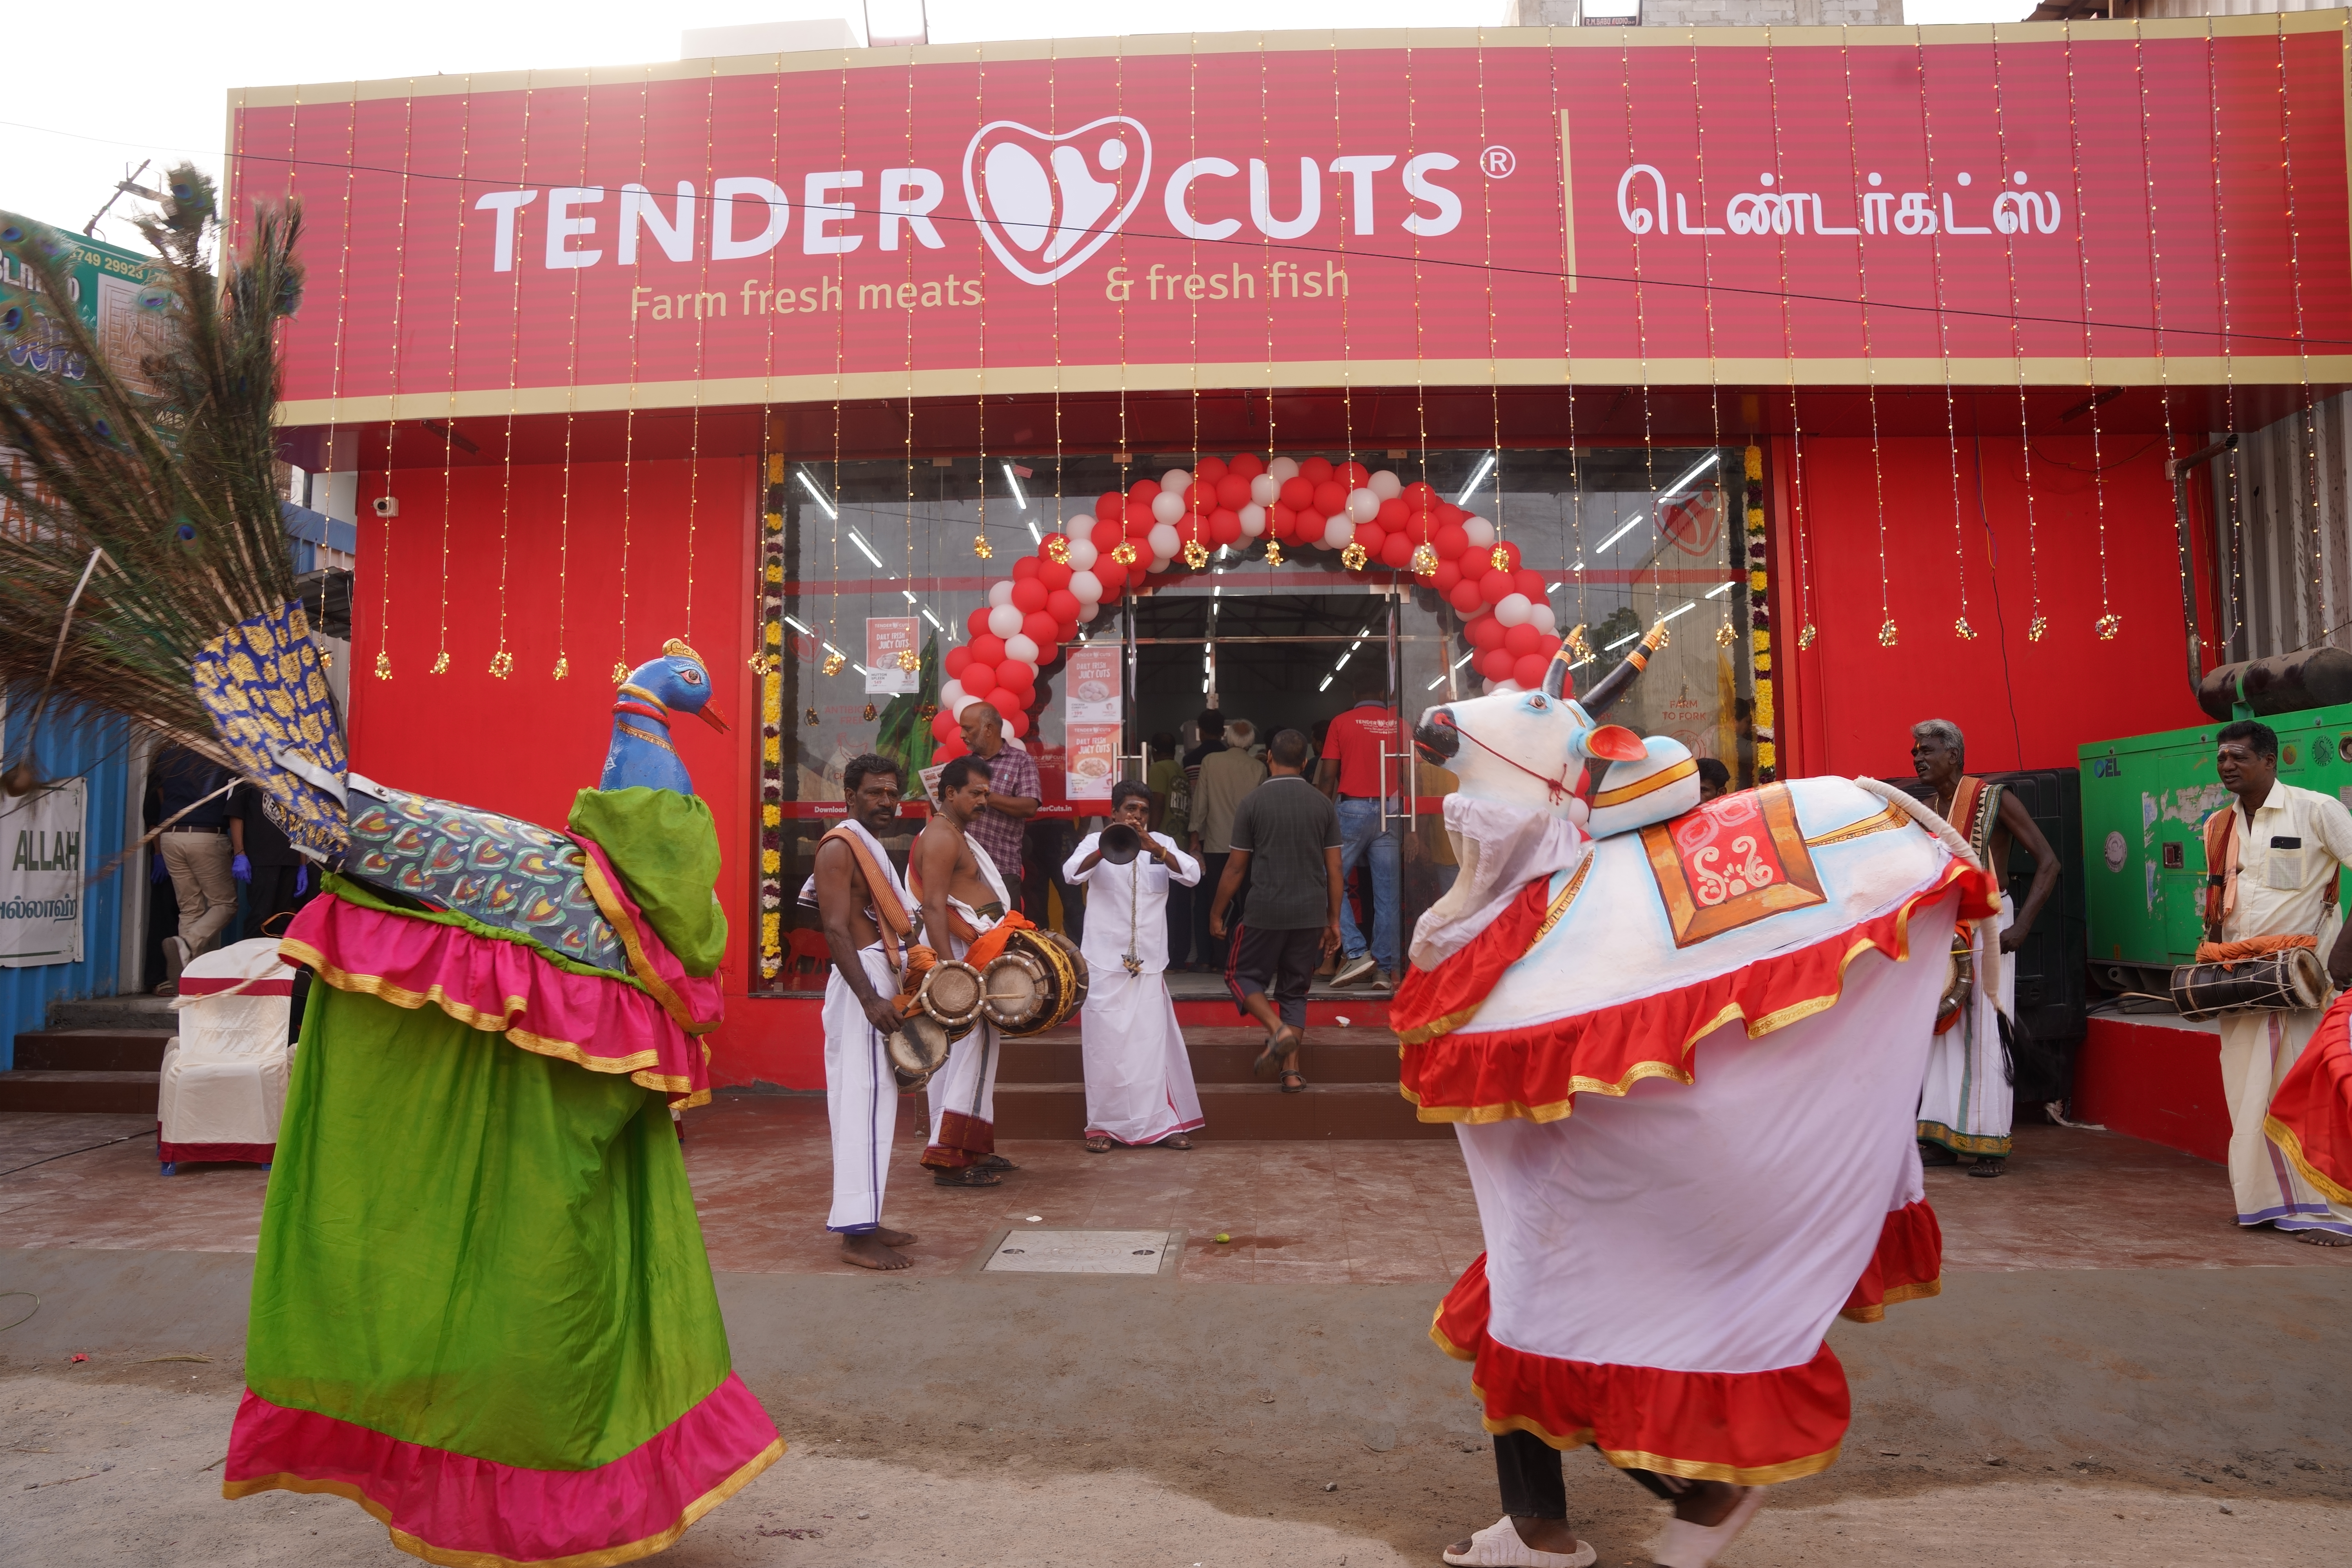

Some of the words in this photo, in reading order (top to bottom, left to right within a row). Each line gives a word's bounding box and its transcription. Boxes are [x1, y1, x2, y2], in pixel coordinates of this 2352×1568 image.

[1617, 164, 2061, 236] டெண்டர்கட்ஸ்
[474, 168, 946, 272] TENDER
[1164, 152, 1462, 240] CUTS
[1105, 266, 1134, 301] &
[1146, 262, 1255, 301] fresh
[1268, 260, 1349, 298] fish
[631, 287, 727, 321] Farm
[740, 276, 842, 315] fresh
[858, 274, 982, 310] meats
[878, 640, 894, 650] JUICY
[895, 639, 909, 648] CUTS
[1078, 670, 1094, 679] JUICY
[1096, 669, 1110, 677] CUTS
[825, 705, 880, 713] ANTIBIOC
[1670, 700, 1698, 708] FARM
[1662, 712, 1676, 720] TO
[1679, 712, 1706, 720] FORK
[1078, 745, 1094, 755] JUICY
[1096, 744, 1110, 753] CUTS
[13, 830, 79, 871] ALLAH
